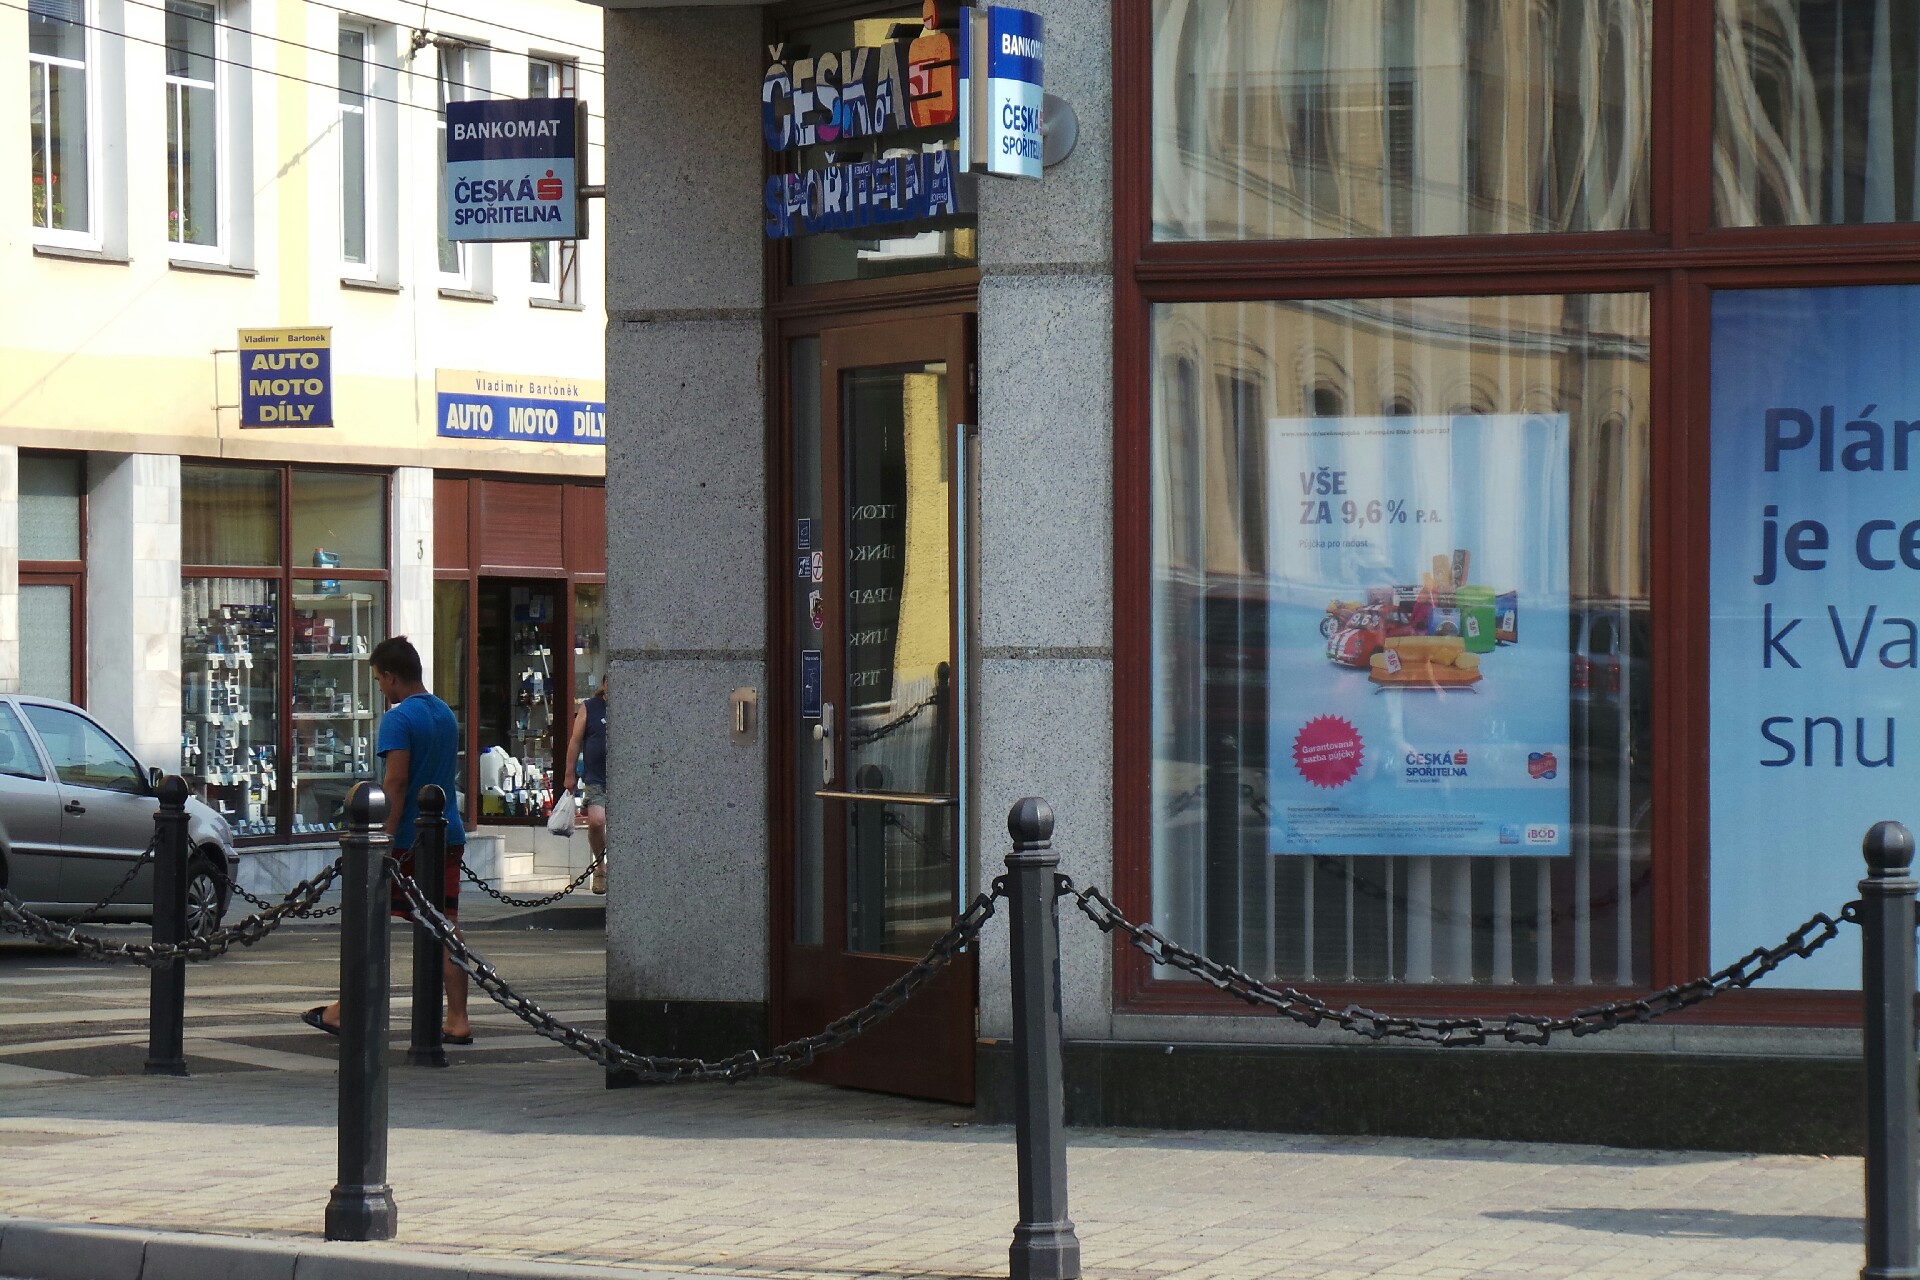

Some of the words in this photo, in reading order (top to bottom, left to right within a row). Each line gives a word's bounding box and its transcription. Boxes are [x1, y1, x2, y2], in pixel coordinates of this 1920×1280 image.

[1002, 33, 1043, 60] BANKOM
[1002, 97, 1039, 133] ČESKÁ
[454, 119, 561, 141] BANKOMAT
[454, 175, 536, 204] ČESKÁ
[454, 203, 562, 225] SPOŘITELNA
[251, 352, 320, 370] AUTO
[249, 378, 324, 396] MOTO
[259, 400, 315, 422] DÍLY
[446, 403, 494, 432] AUTO
[508, 407, 559, 436] MOTO
[1299, 466, 1347, 496] VŠE
[1299, 500, 1333, 525] ZA
[417, 539, 424, 560] 3
[1327, 540, 1341, 549] pro
[1753, 504, 1829, 586] je
[1763, 602, 1803, 669] k
[1827, 605, 1918, 669] Va
[1302, 739, 1354, 754] Garantovaná
[1760, 716, 1895, 768] snu
[1303, 754, 1327, 764] sazba
[1405, 750, 1453, 766] ČESKÁ
[1405, 764, 1469, 777] SPOŘITELNA
